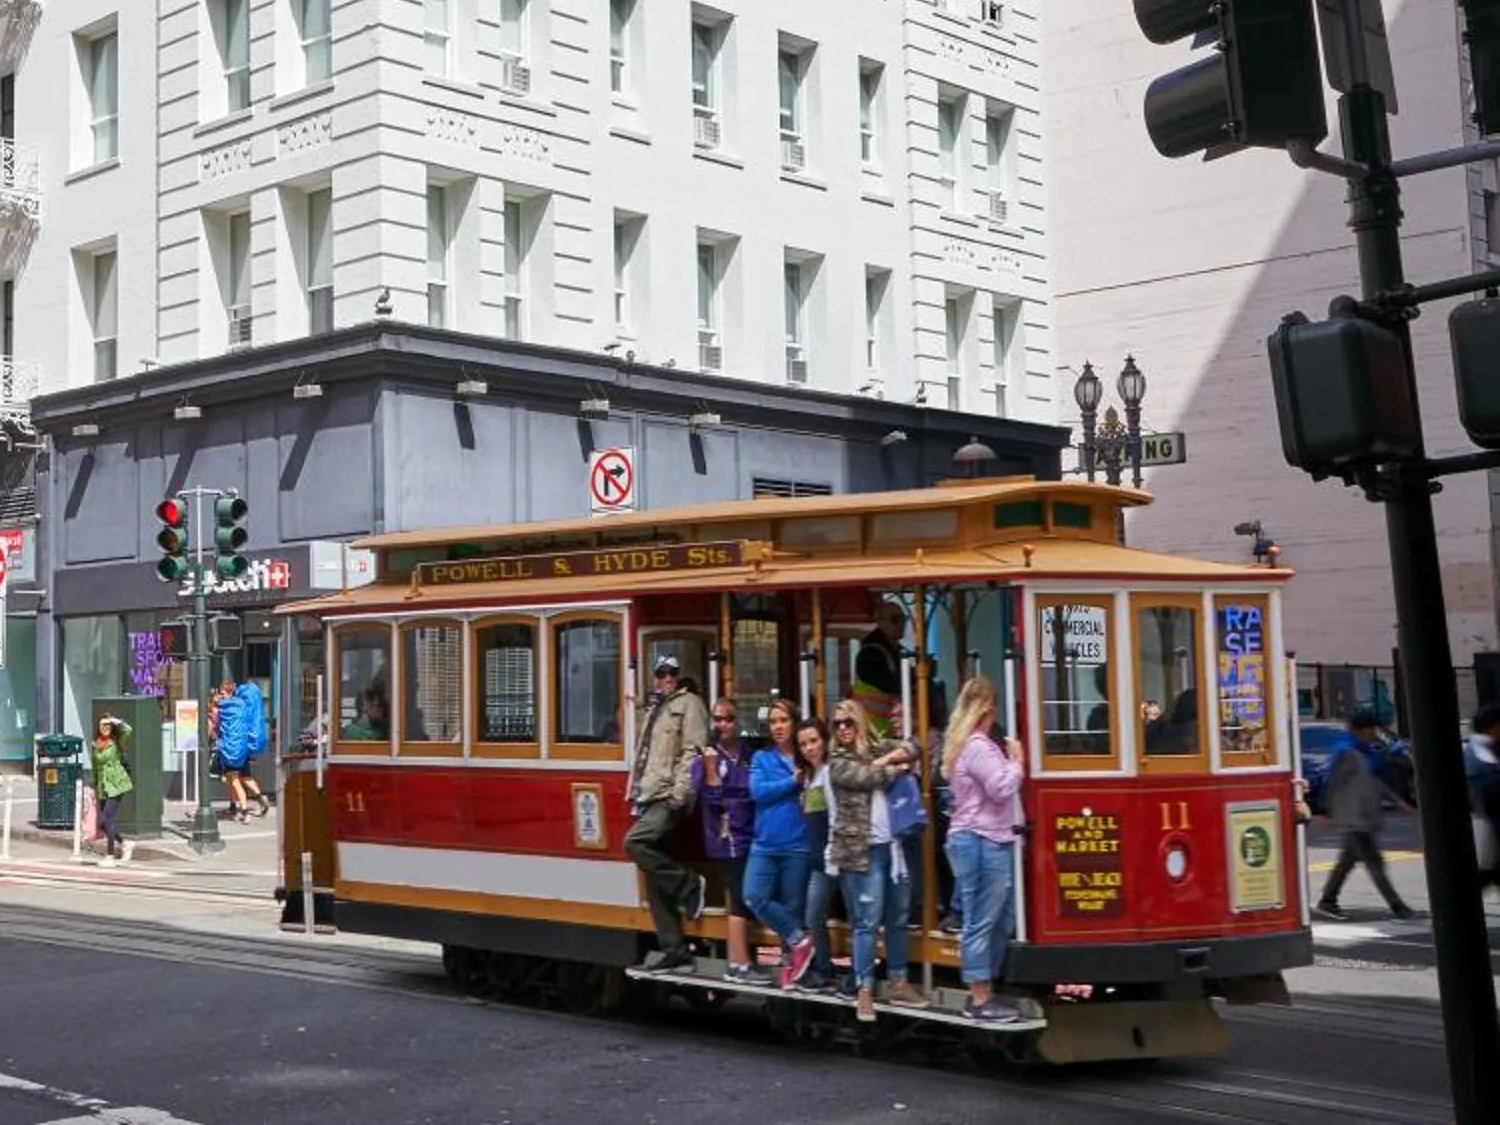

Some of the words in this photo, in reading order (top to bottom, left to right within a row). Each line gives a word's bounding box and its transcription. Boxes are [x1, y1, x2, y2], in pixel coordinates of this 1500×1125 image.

[432, 561, 532, 583] POWELL
[553, 557, 572, 574] &
[594, 549, 670, 572] HYDE
[687, 546, 732, 566] Sts.
[345, 791, 364, 812] 11
[1055, 816, 1119, 830] POWELL
[1160, 801, 1192, 830] 11
[1072, 830, 1104, 839] AND
[1055, 840, 1120, 853] MARKET
